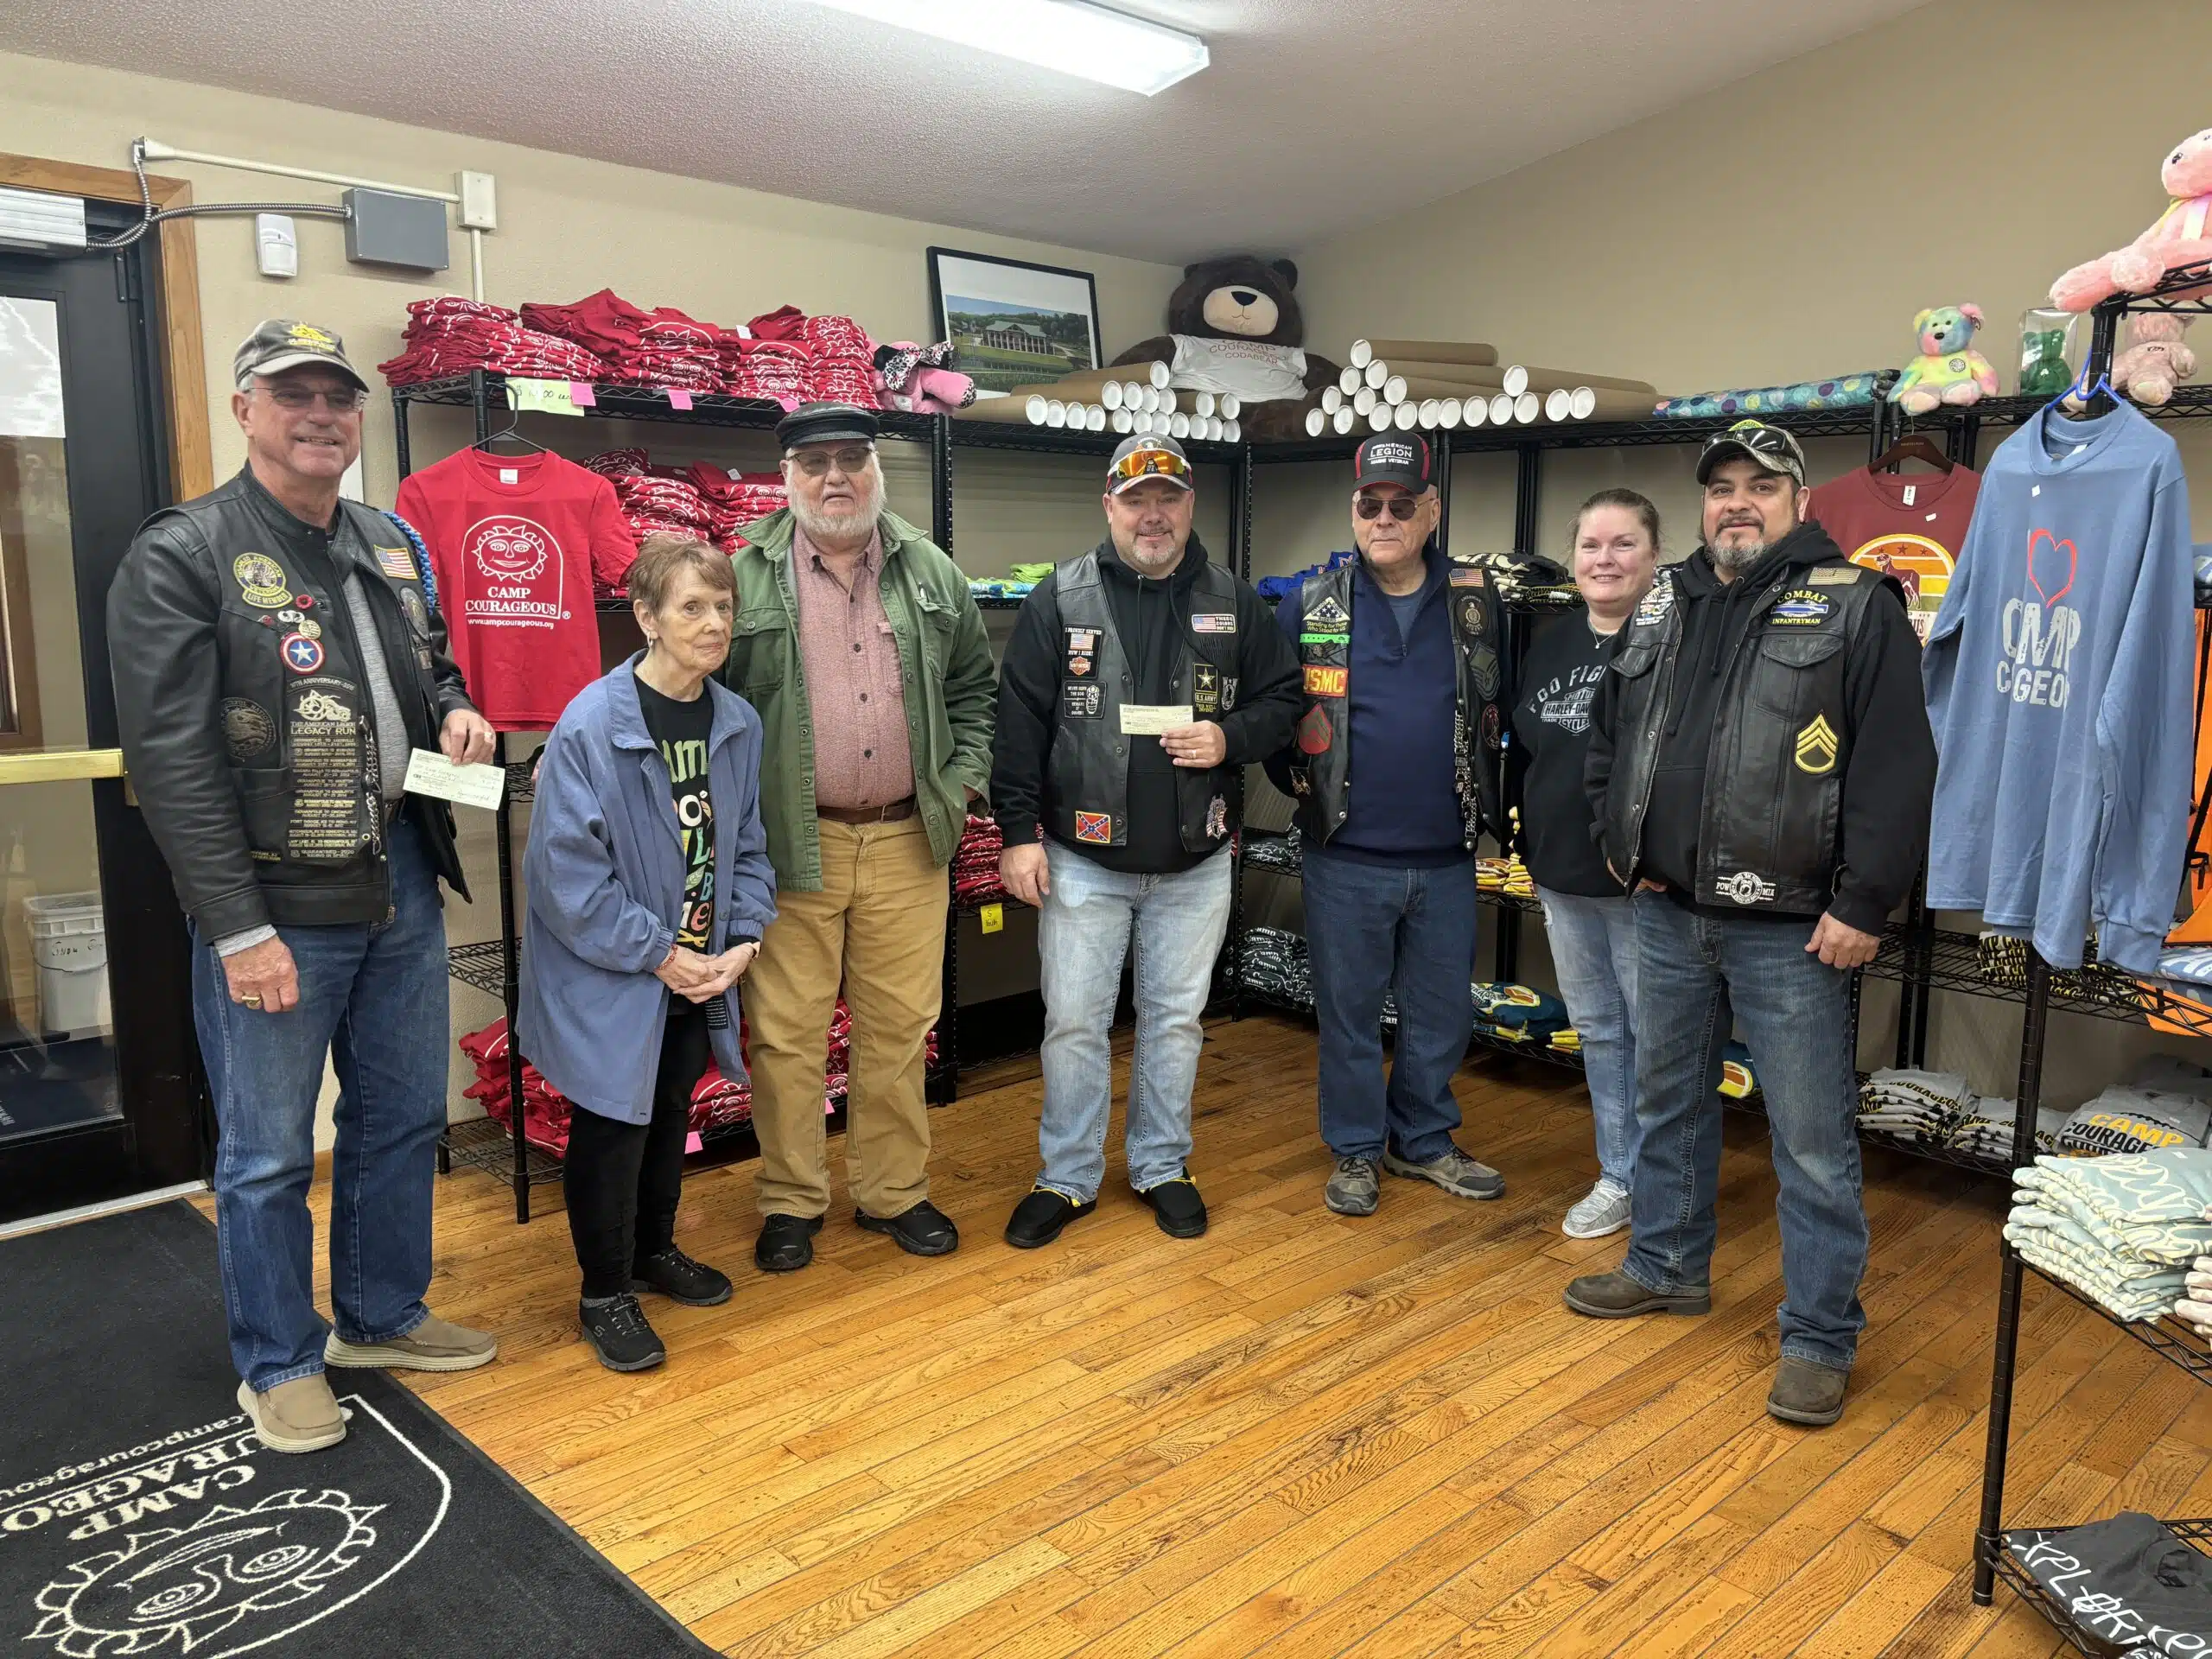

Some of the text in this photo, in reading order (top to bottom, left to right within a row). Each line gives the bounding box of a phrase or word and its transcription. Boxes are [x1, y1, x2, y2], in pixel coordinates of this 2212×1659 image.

[1225, 352, 1278, 365] CODABEAR
[1370, 448, 1412, 458] LEGION
[487, 586, 531, 599] CAMP
[1777, 589, 1828, 604] COMBAT
[465, 600, 557, 615] COURAGEOUS
[1303, 667, 1345, 693] USMC
[1526, 664, 1607, 714] FOO FIG
[1543, 702, 1590, 716] HARLEY-DAV
[290, 727, 356, 735] LEGACY RUN
[1716, 882, 1775, 897] POW MIA
[987, 909, 993, 918] S
[2088, 1114, 2184, 1148] CAMP
[67, 1465, 256, 1541] CAMP
